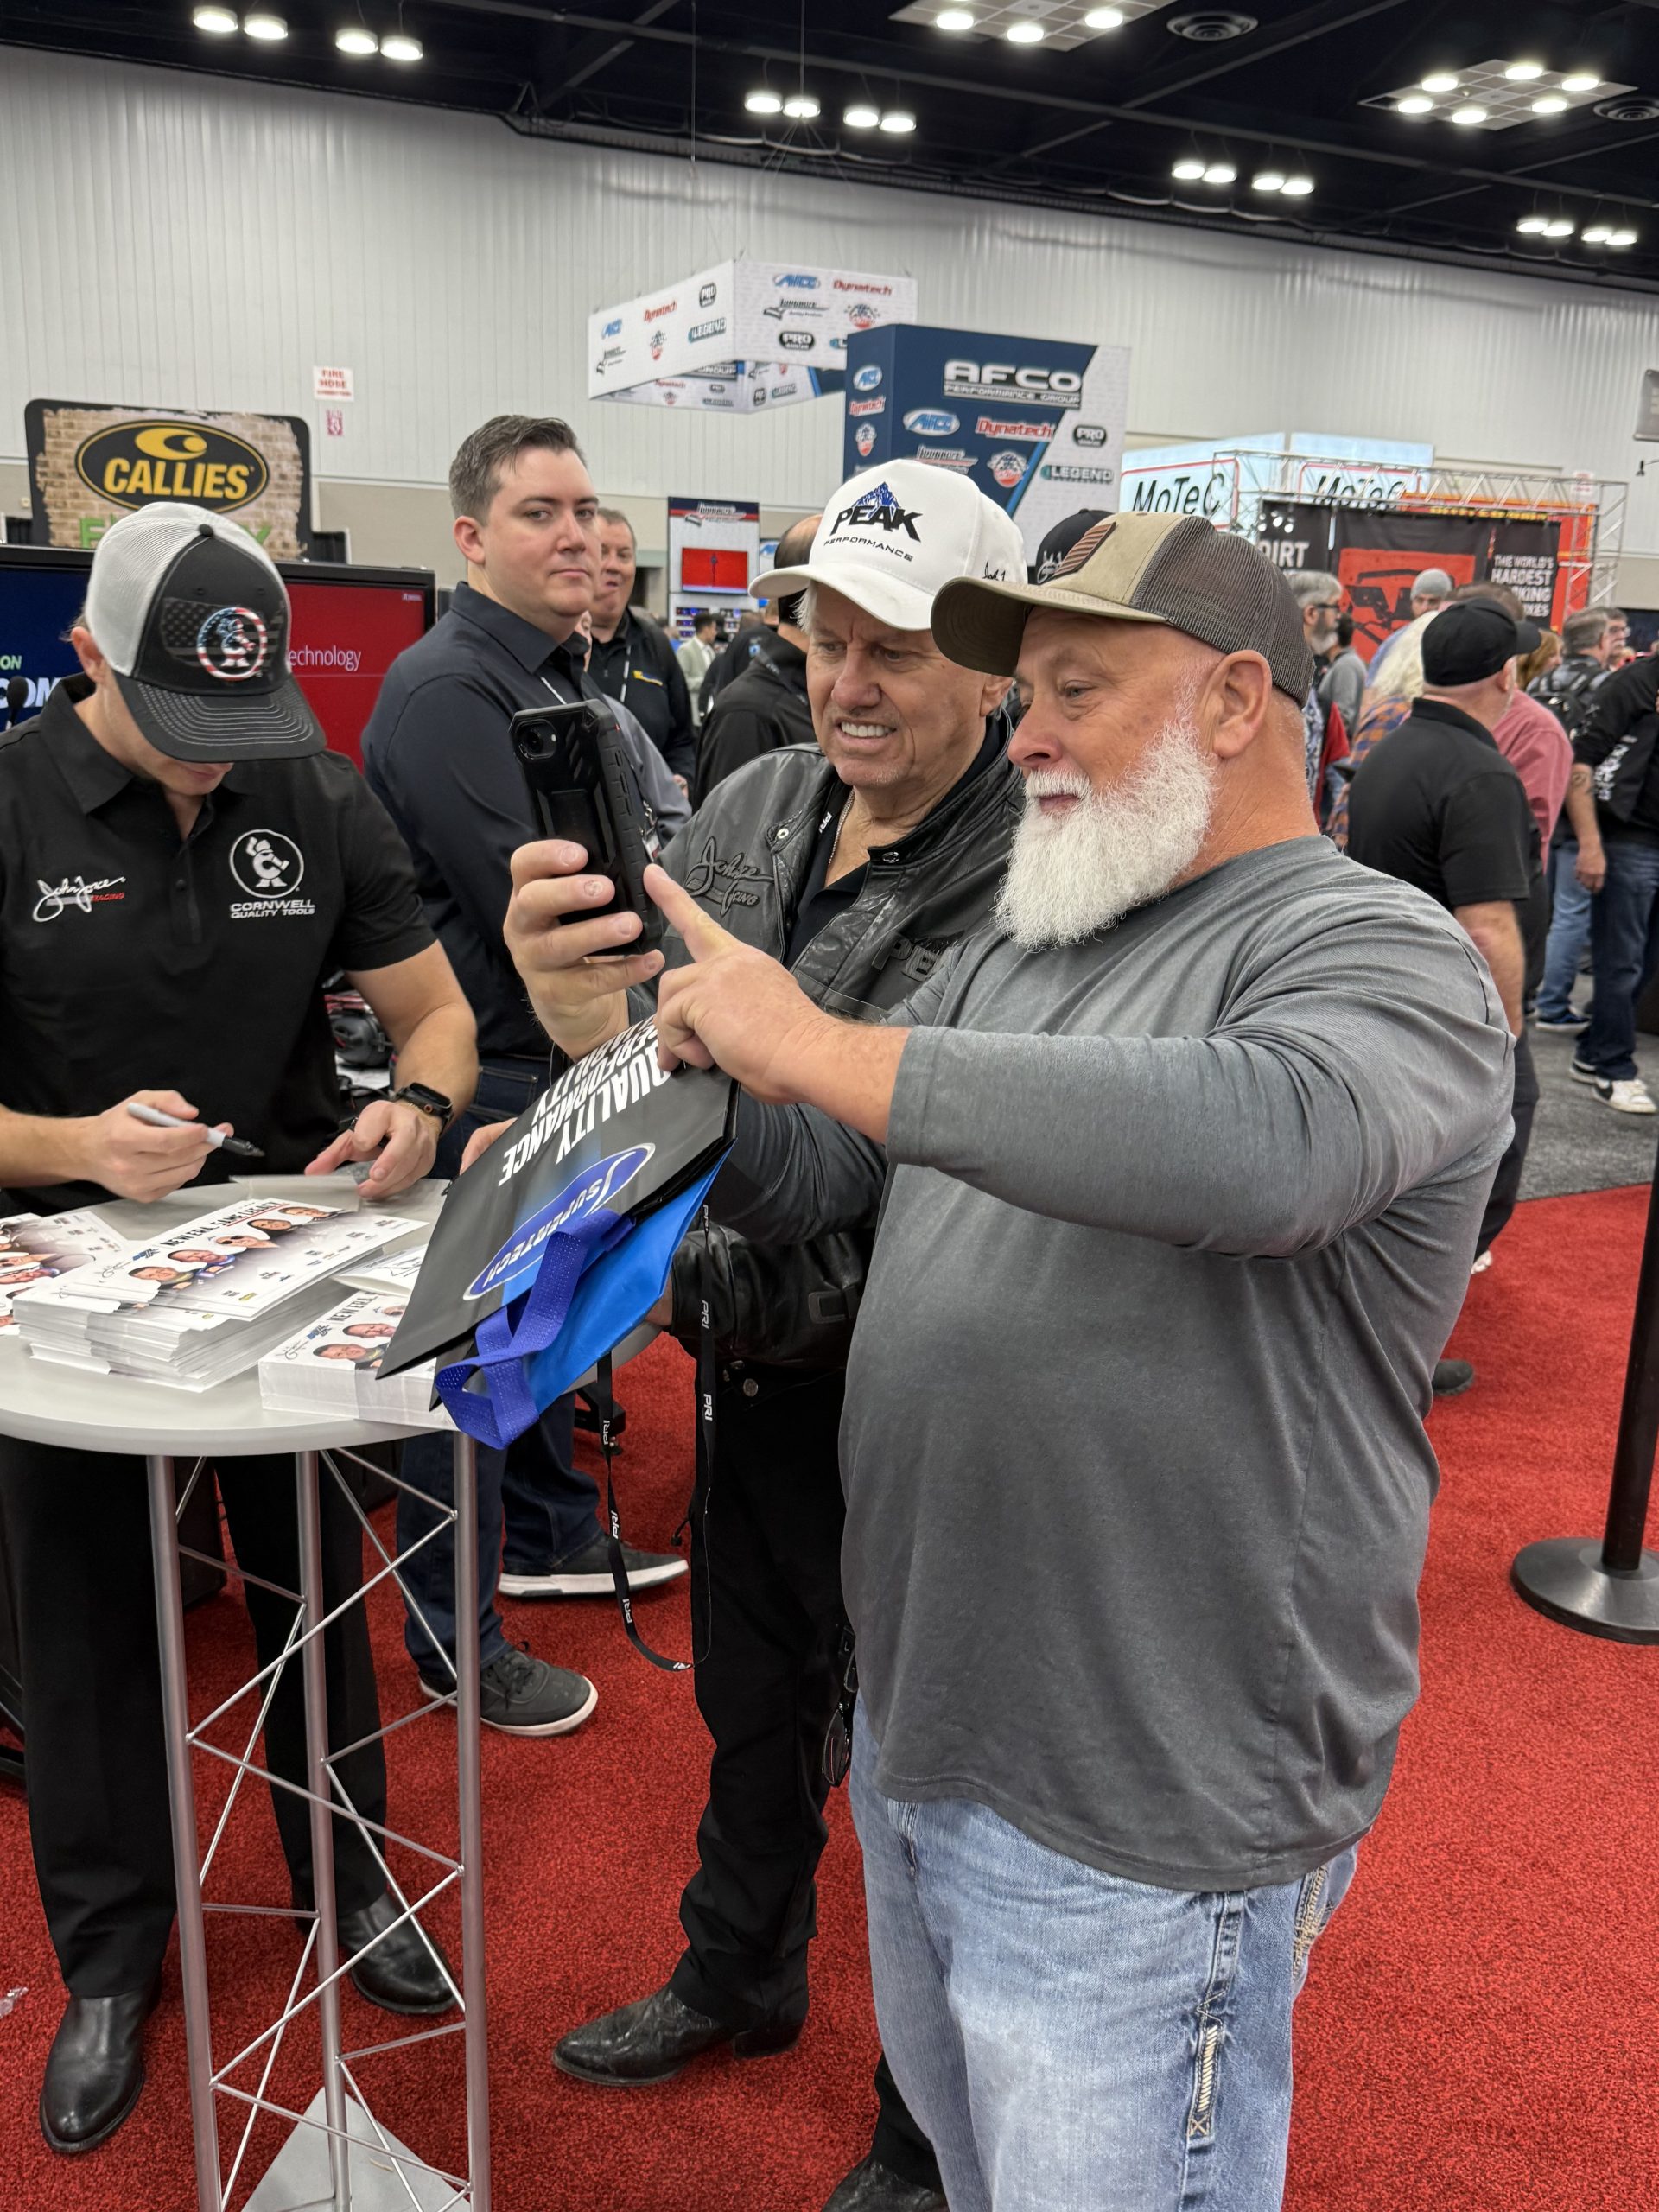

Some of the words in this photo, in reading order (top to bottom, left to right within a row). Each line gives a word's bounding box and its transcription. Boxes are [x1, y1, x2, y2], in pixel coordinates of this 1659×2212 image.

[782, 333, 813, 346] PRO
[944, 360, 1081, 392] AFCO
[976, 416, 1052, 439] Dynatech
[1076, 427, 1105, 440] PRO
[104, 458, 250, 500] CALLIES
[1051, 467, 1112, 481] LEGEND
[1132, 473, 1225, 515] MoTeC
[830, 505, 924, 543] PEAK
[823, 536, 914, 562] PERFORMANCE
[1494, 555, 1513, 567] THE
[1491, 568, 1553, 586] HARDEST
[289, 645, 361, 672] echnology
[819, 811, 832, 833] PRI
[231, 899, 315, 912] CORNWELL
[231, 909, 278, 918] QUALITY
[556, 1039, 671, 1165] QUALITY
[701, 1300, 709, 1329] PRI
[703, 1393, 713, 1421] PRI
[611, 1510, 620, 1540] PRI
[622, 1598, 632, 1624] PRI
